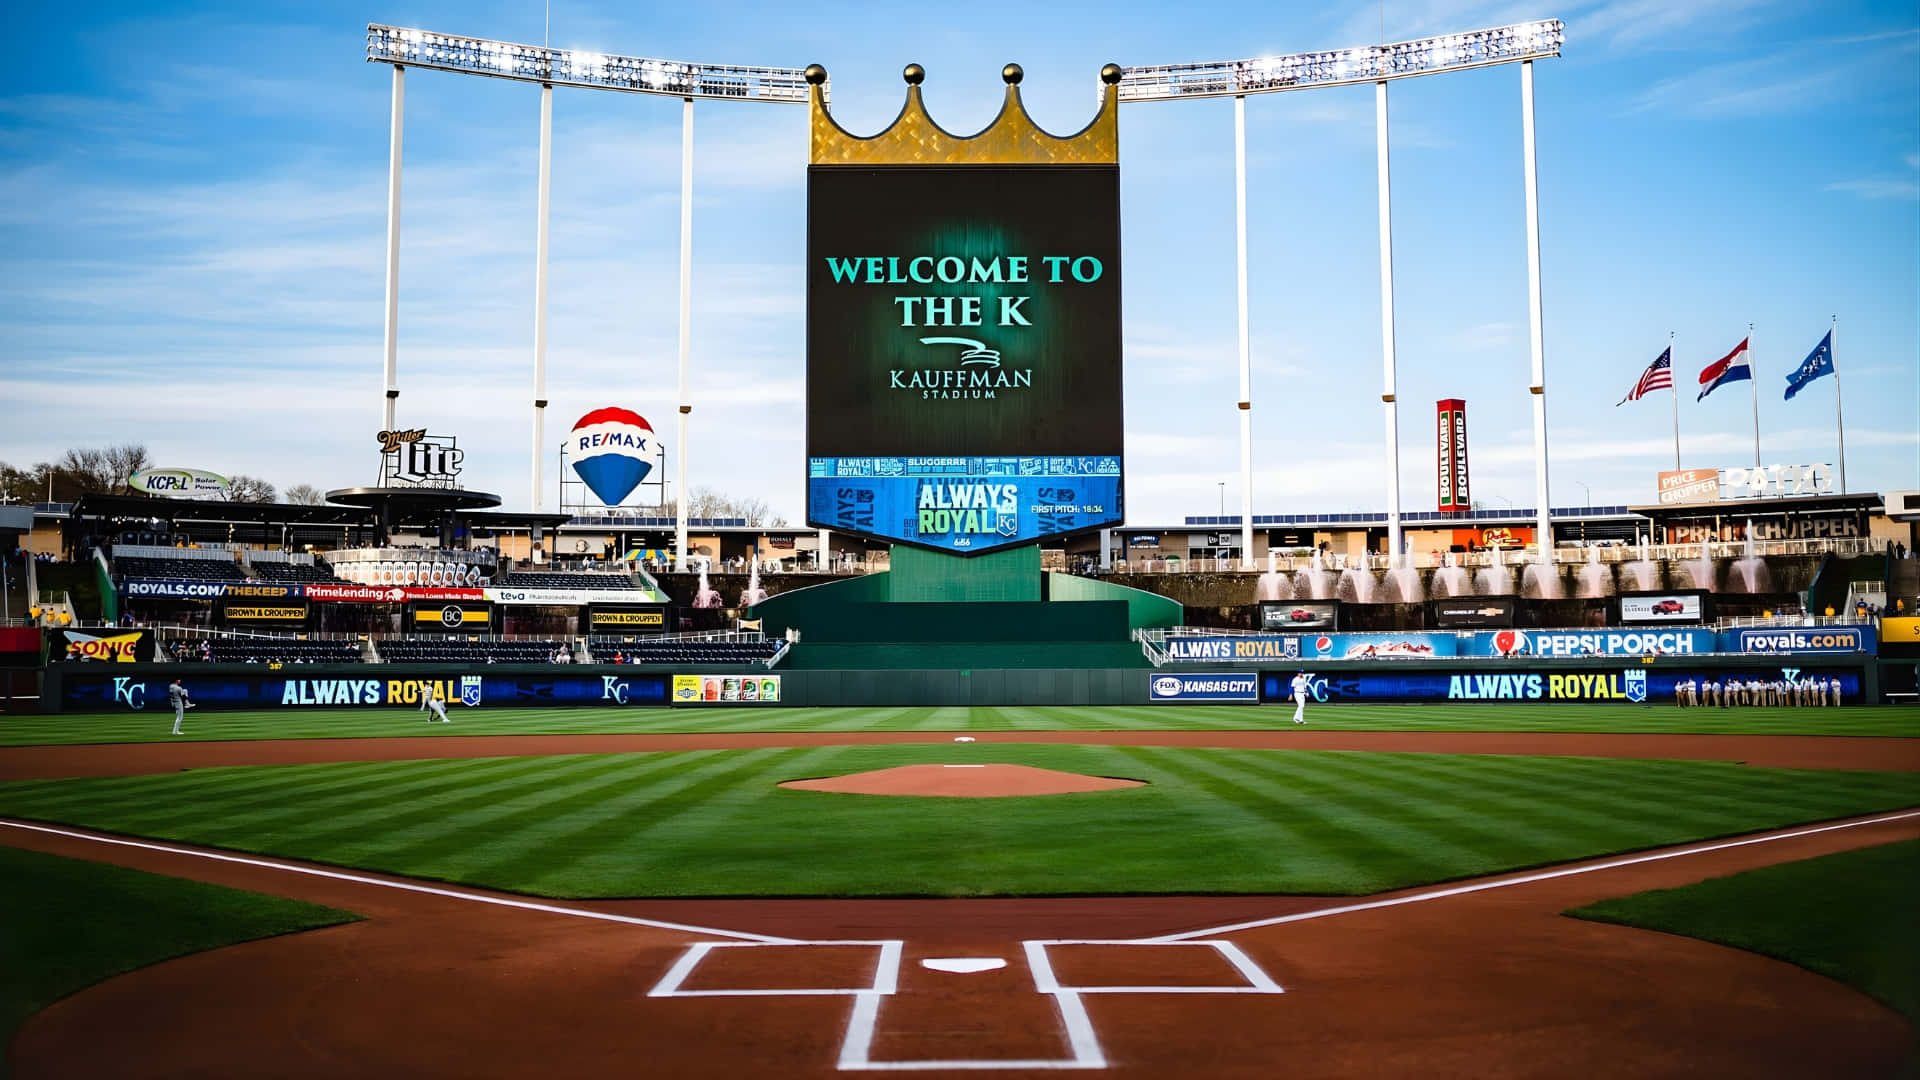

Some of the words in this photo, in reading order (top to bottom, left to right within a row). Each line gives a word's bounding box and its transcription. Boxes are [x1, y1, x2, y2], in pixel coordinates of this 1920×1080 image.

[825, 256, 1028, 284] WELCOME
[1042, 256, 1103, 283] TO
[895, 297, 982, 326] THE
[998, 297, 1032, 326] K
[890, 369, 1032, 389] KAUFFMAN
[923, 390, 996, 399] STADIUM
[377, 429, 426, 453] Miller
[580, 432, 646, 451] RE/MAX
[394, 441, 464, 482] Lite
[838, 459, 871, 467] ALWAYS
[1440, 418, 1449, 495] BOULEVARD
[1456, 417, 1467, 496] BOULEVARD
[838, 468, 864, 476] ROYAL
[1078, 458, 1094, 473] KC
[146, 476, 188, 490] KCP&L
[1662, 471, 1697, 489] PRICE
[919, 484, 1018, 509] ALWAYS
[1661, 479, 1718, 502] CHOPPER
[1031, 505, 1054, 513] FIRST
[919, 509, 996, 534] ROYAL
[999, 515, 1016, 530] KC
[129, 582, 289, 597] ROYALS.COM/THEKEEP
[306, 587, 384, 600] PrimeLending
[500, 591, 525, 601] teva
[227, 608, 255, 617] BROWN
[257, 609, 263, 617] &
[264, 608, 304, 618] CROUPPEN
[444, 610, 461, 622] BC
[592, 614, 618, 622] BROWN
[619, 614, 625, 622] &
[626, 614, 661, 623] CROUPPEN
[70, 640, 136, 656] SONIC
[1537, 634, 1602, 655] PEPSI
[1607, 633, 1693, 655] PORCH
[1746, 632, 1855, 648] royals.com
[1169, 641, 1231, 657] ALWAYS
[1235, 641, 1285, 656] ROYAL
[1286, 645, 1297, 655] KC
[113, 677, 145, 710] KC
[282, 680, 380, 704] ALWAYS
[464, 686, 479, 701] KC
[601, 675, 629, 705] KC
[1184, 680, 1228, 693] KANSAS
[1448, 674, 1542, 699] ALWAYS
[1549, 674, 1626, 699] ROYAL
[1628, 679, 1645, 696] KC
